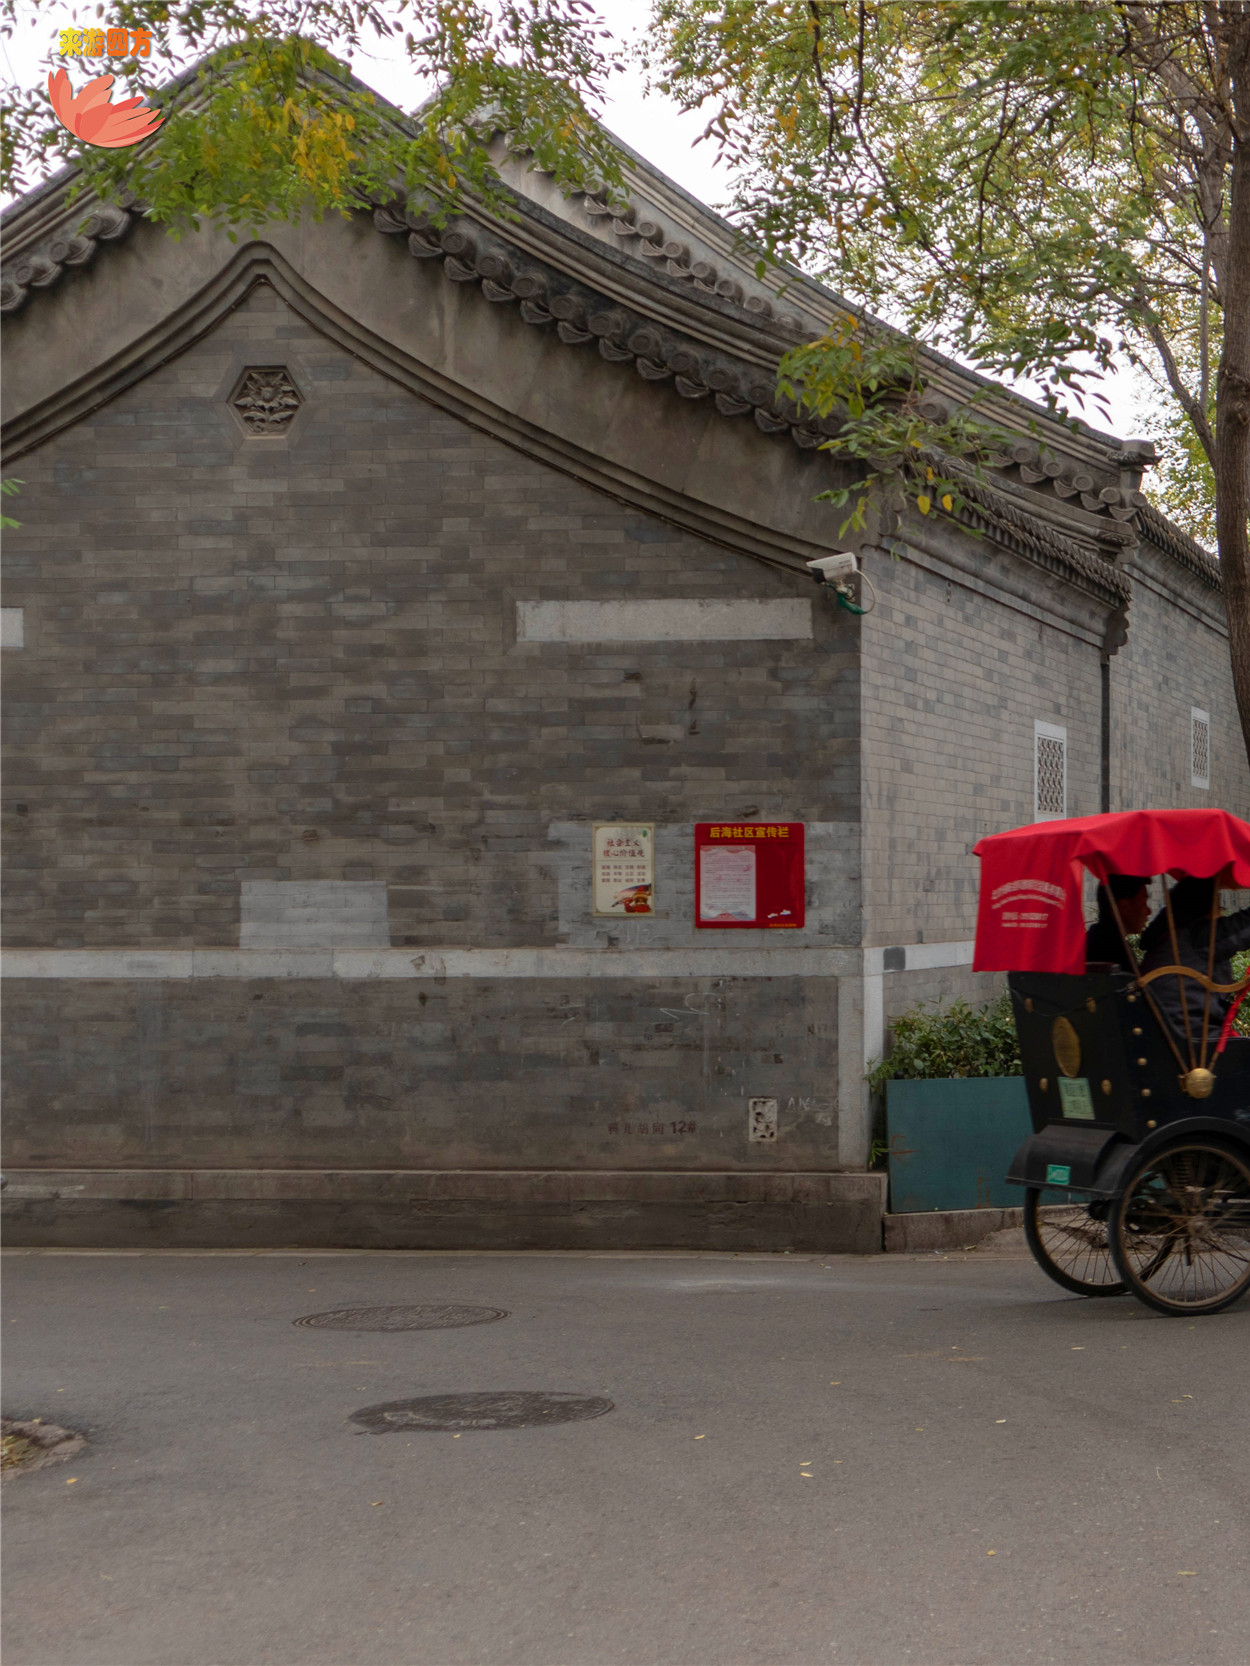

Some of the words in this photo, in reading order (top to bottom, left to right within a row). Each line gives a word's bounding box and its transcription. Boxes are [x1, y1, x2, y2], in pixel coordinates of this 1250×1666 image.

[709, 826, 789, 838] 后海社区宣传栏
[607, 838, 640, 847] 社会主义
[603, 849, 645, 858] 核心价值观
